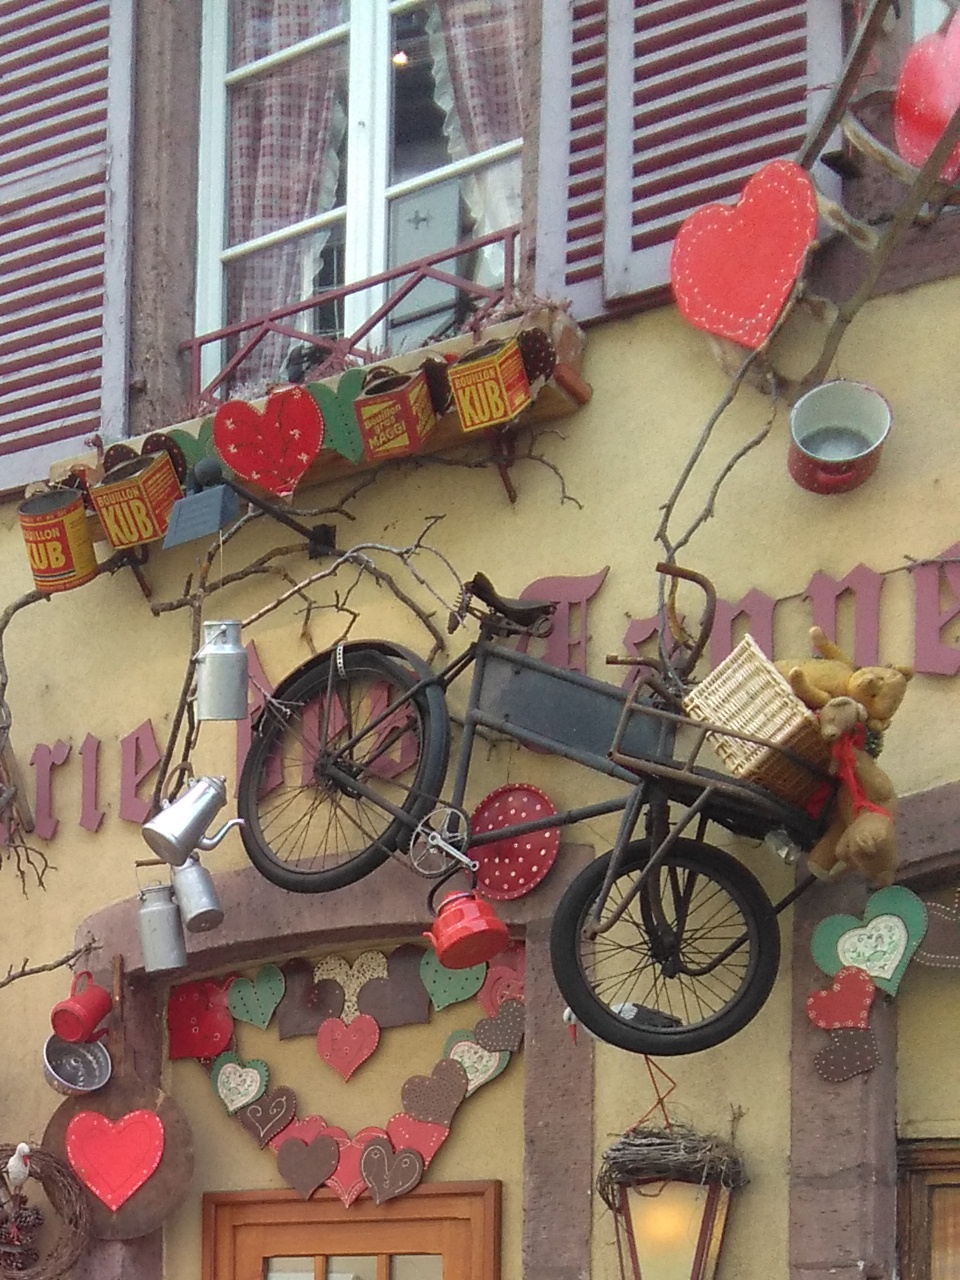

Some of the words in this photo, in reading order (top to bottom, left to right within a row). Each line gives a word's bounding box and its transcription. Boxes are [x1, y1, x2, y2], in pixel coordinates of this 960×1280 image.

[455, 367, 496, 389] BOUILLON
[458, 380, 505, 426] KUB
[369, 420, 406, 449] MAGGI
[97, 486, 139, 508] BOUILLON
[102, 500, 153, 546] KUB
